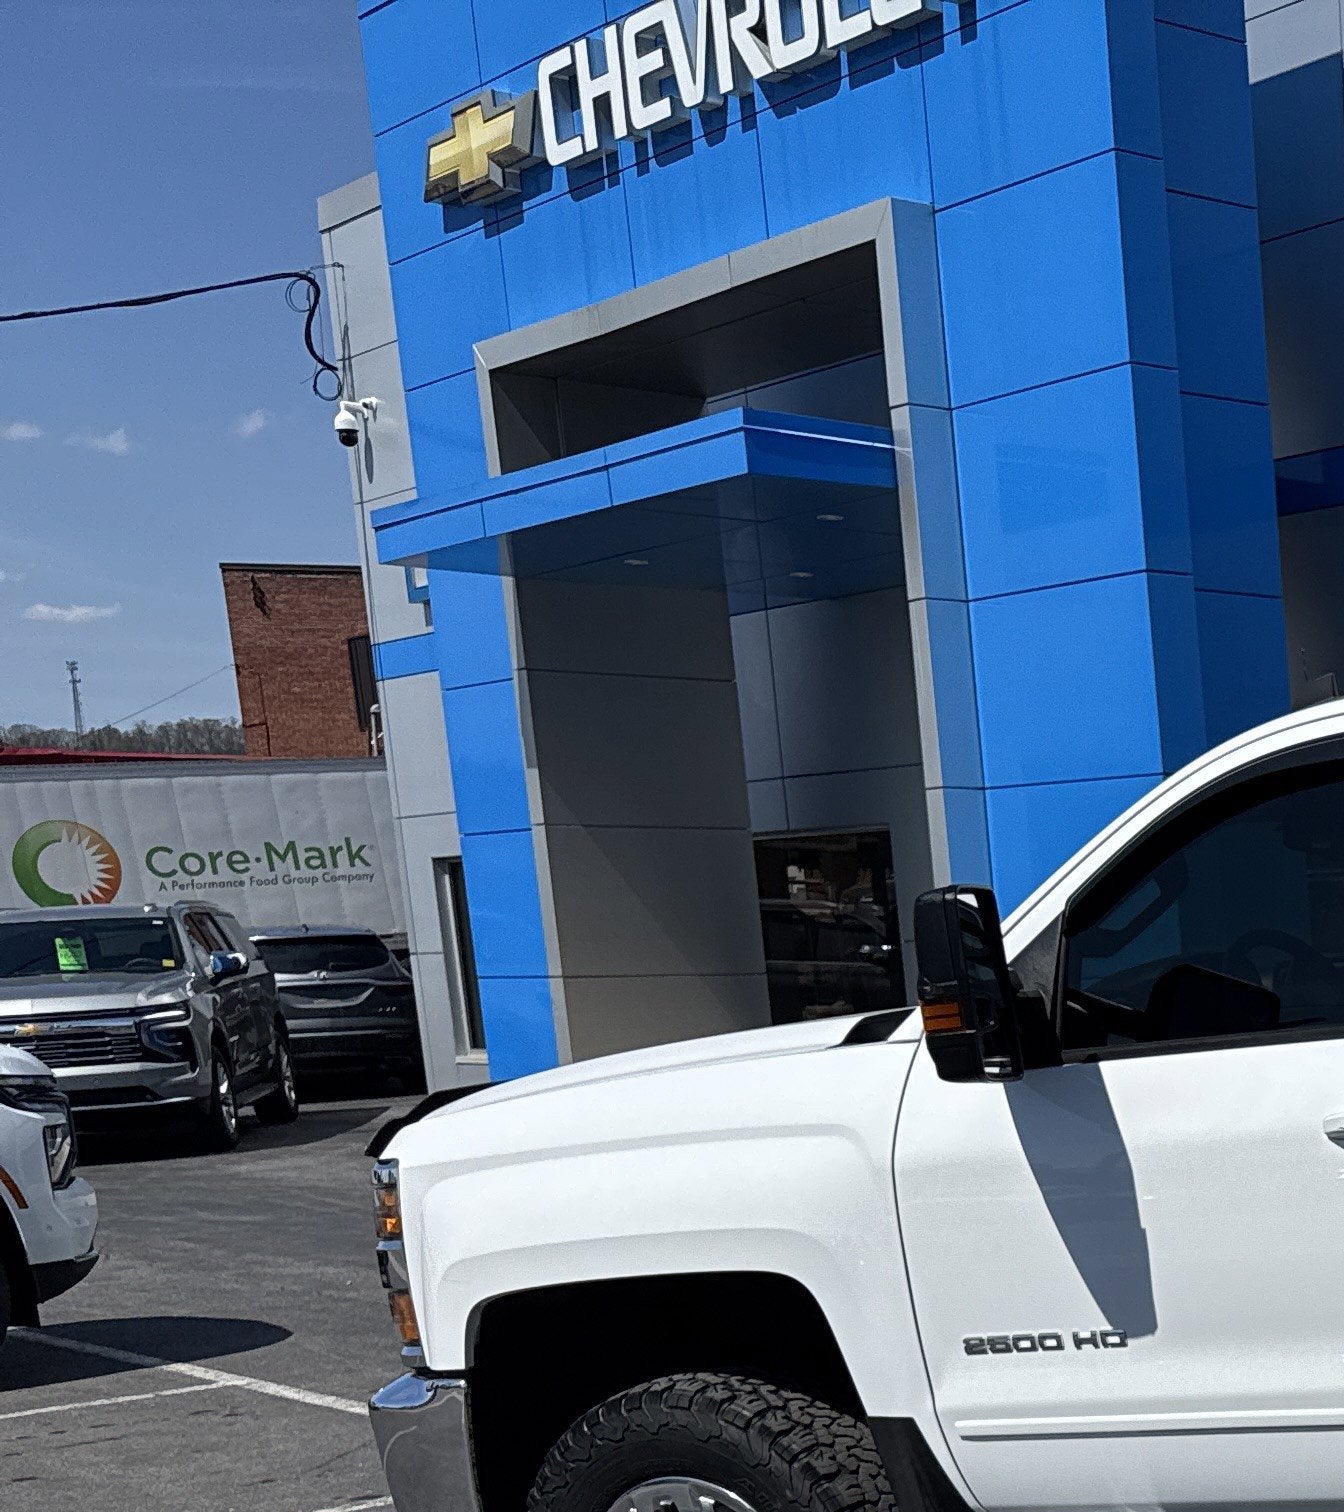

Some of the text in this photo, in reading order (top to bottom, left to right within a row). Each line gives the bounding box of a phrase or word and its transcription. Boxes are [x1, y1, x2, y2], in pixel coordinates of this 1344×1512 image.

[537, 0, 922, 166] CHEVROL
[158, 871, 375, 892] A Performance Food Group Company
[963, 1329, 1129, 1356] 2500 HD
